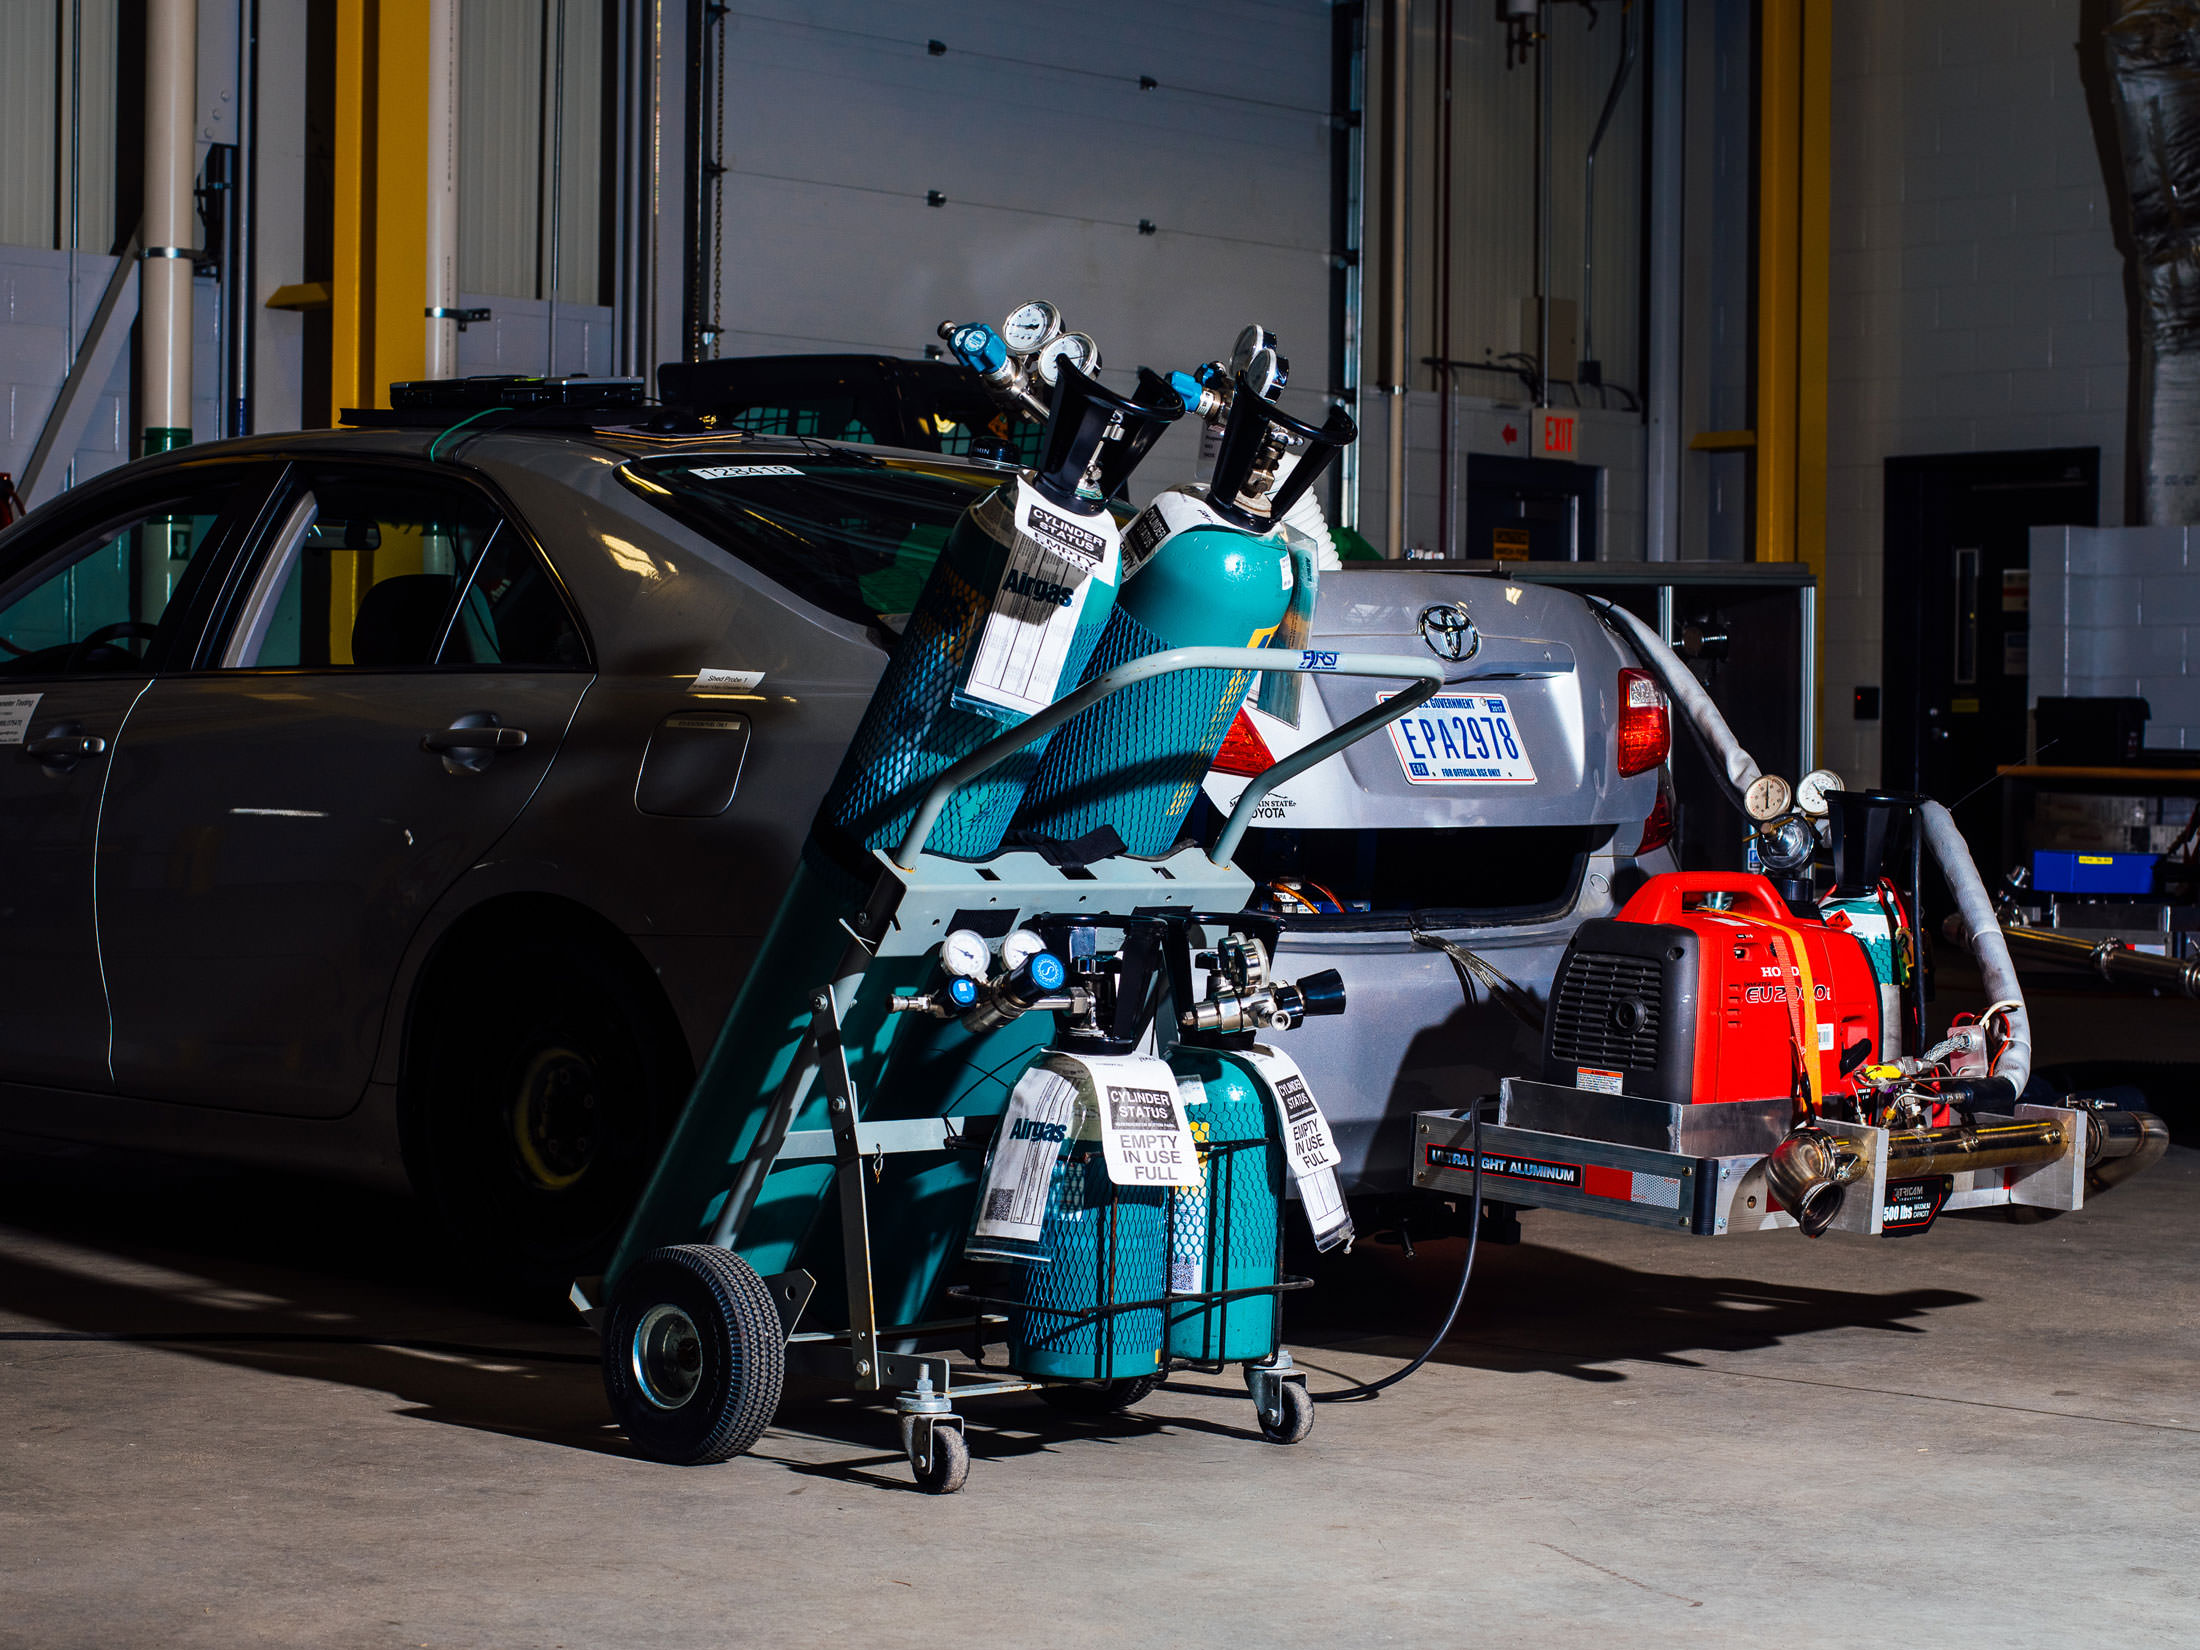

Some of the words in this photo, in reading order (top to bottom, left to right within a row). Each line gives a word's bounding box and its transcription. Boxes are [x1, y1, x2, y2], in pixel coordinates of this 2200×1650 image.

[1545, 416, 1574, 453] EXIT
[1033, 508, 1104, 547] CYLINDER
[1039, 521, 1095, 552] STATUS
[1002, 569, 1074, 607] Airgas
[1430, 697, 1475, 709] GOVERNMENT
[1400, 717, 1519, 760] EPA2978
[1411, 764, 1427, 775] EPA
[1441, 768, 1453, 777] FOR
[1453, 768, 1477, 777] OFFICIAL
[1477, 768, 1486, 777] USE
[1488, 768, 1501, 777] ONLY
[1252, 807, 1286, 819] OYOTA
[1760, 966, 1801, 977] HOD
[1745, 984, 1832, 1004] EU20i
[1278, 1079, 1304, 1097] CYLINDER
[1110, 1090, 1170, 1106] CYLINDER
[1287, 1092, 1309, 1110] STATUS
[1119, 1106, 1168, 1119] STATUS
[1009, 1118, 1067, 1143] Airgas
[1292, 1118, 1319, 1141] EMPTY
[1120, 1134, 1177, 1149] EMPTY
[1295, 1142, 1305, 1156] IN
[1305, 1133, 1325, 1152] USE
[1123, 1150, 1141, 1163] IN
[1145, 1150, 1182, 1164] USE
[1302, 1150, 1329, 1169] FULL
[1431, 1149, 1470, 1167] ULTRA
[1470, 1155, 1507, 1172] LGHT
[1509, 1161, 1575, 1182] ALUMINUM
[1135, 1166, 1178, 1180] FULL
[1883, 1205, 1900, 1222] 500
[1900, 1204, 1913, 1220] lbs
